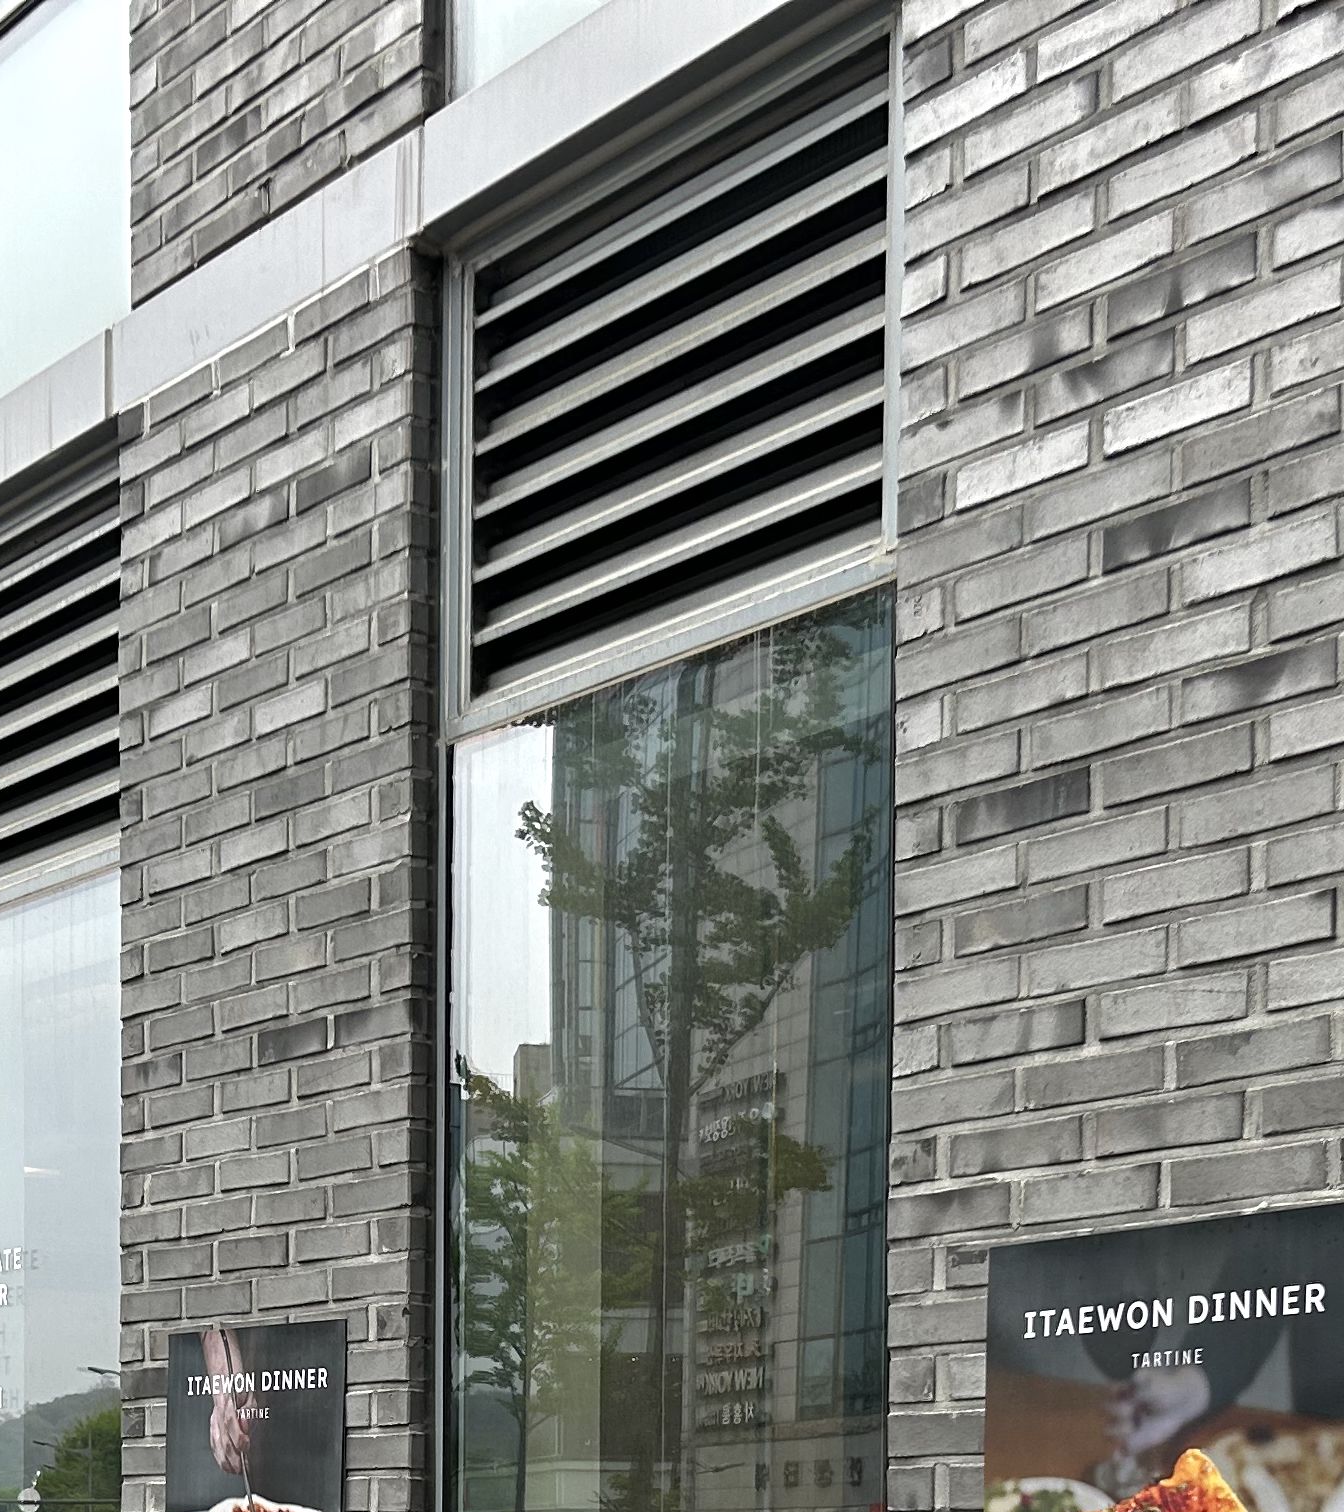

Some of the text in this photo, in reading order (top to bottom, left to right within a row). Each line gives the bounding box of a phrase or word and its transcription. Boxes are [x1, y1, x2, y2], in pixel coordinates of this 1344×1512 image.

[1022, 1282, 1326, 1340] ITAEWON DINNER
[1131, 1348, 1205, 1369] TARTINE
[187, 1367, 328, 1396] ITAEWON DINNER
[236, 1407, 270, 1420] TARTINE
